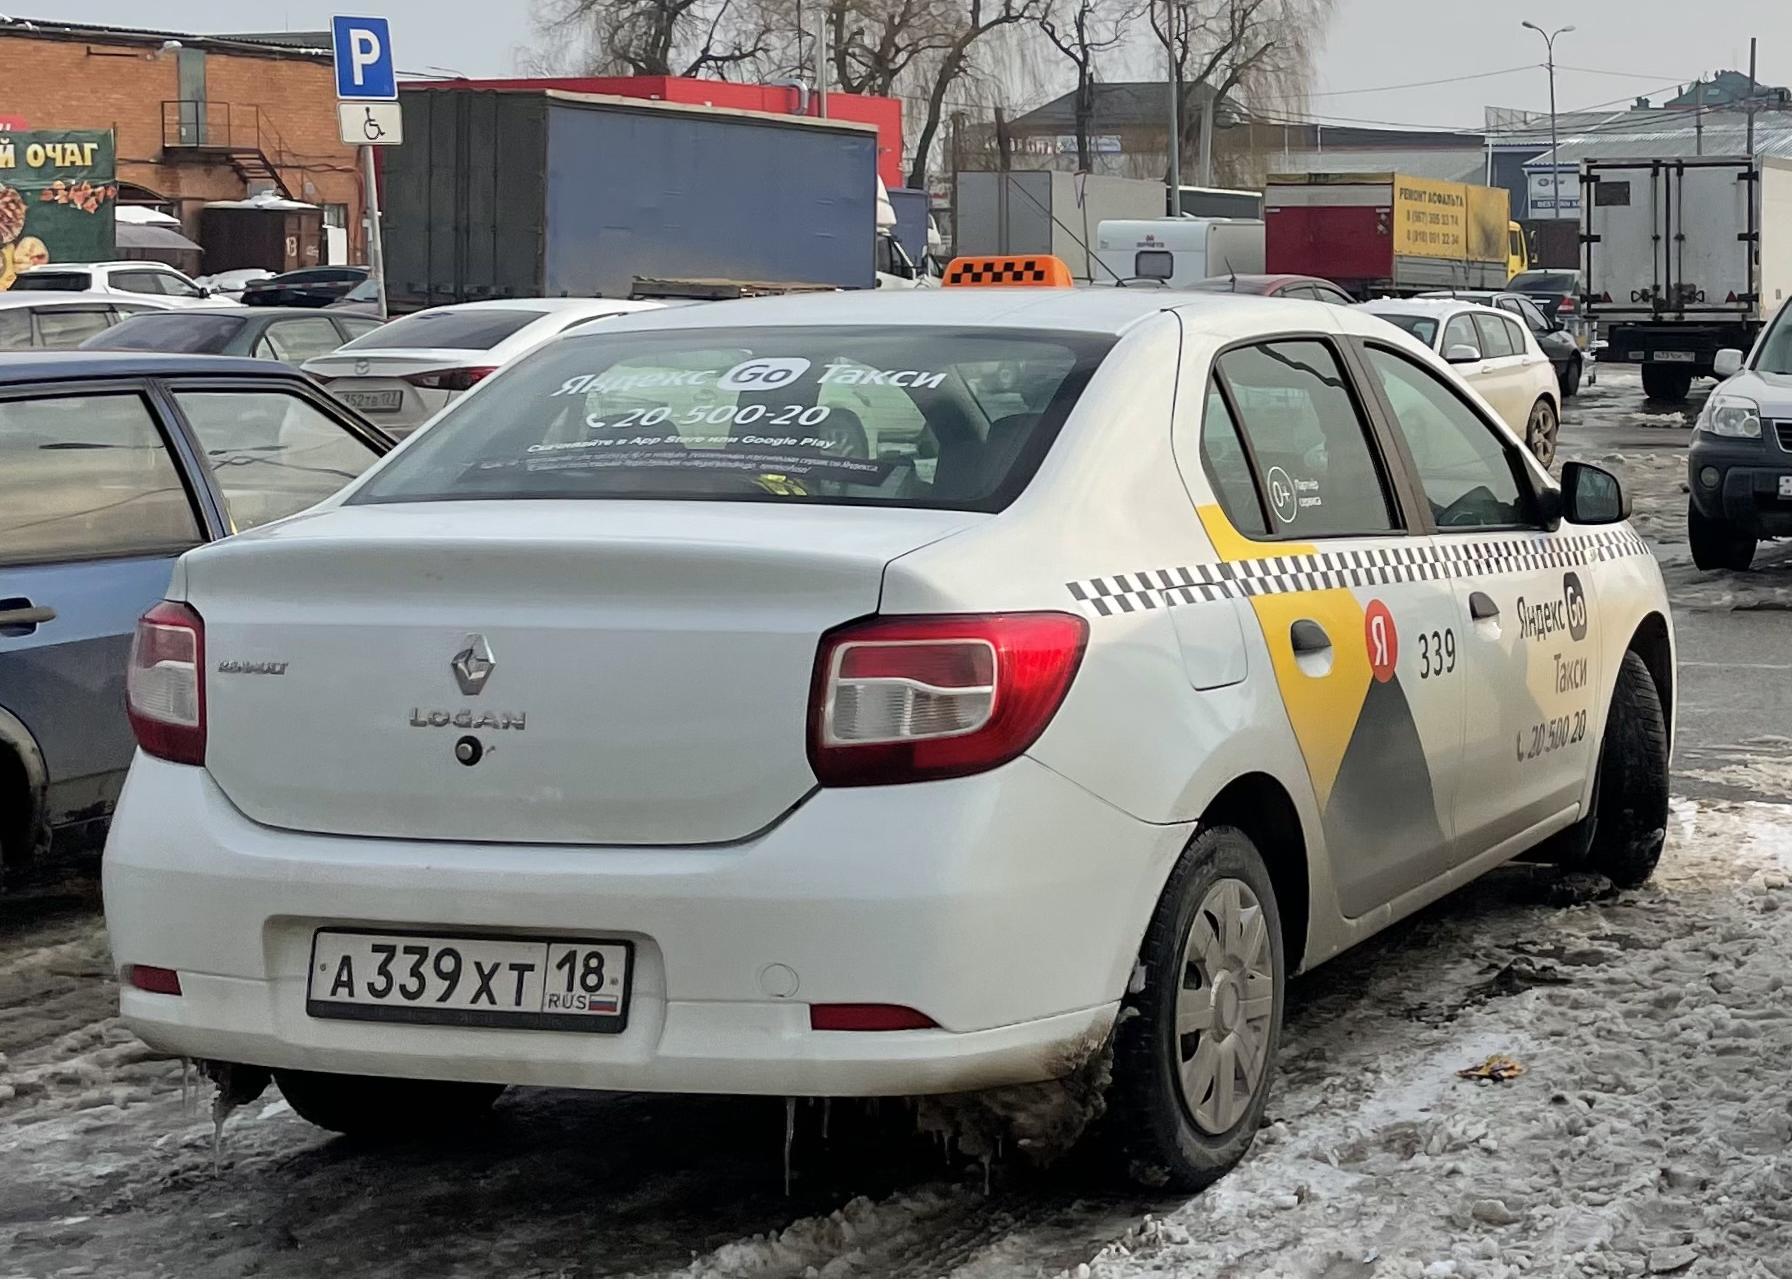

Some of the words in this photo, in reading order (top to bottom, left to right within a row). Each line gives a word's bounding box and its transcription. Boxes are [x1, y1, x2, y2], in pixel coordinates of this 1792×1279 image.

[349, 28, 380, 86] P
[26, 142, 99, 168] ОЧАГ
[551, 370, 719, 397] Яндекс
[731, 364, 793, 384] Go
[817, 363, 947, 389] Такси
[611, 404, 831, 429] 20-500-20
[629, 436, 662, 446] App
[663, 434, 704, 445] Store
[706, 436, 739, 444] или
[742, 434, 799, 446] Google
[800, 437, 837, 449] Play
[1273, 481, 1290, 507] 0+
[1517, 596, 1566, 642] Яндекс
[1566, 586, 1586, 628] Go
[1372, 615, 1388, 666] Я
[1418, 627, 1456, 679] 339
[1554, 653, 1588, 694] Такси
[408, 706, 526, 730] LOGAN
[329, 943, 536, 1007] А339ХТ
[555, 949, 604, 993] 18
[547, 993, 587, 1010] RUS
